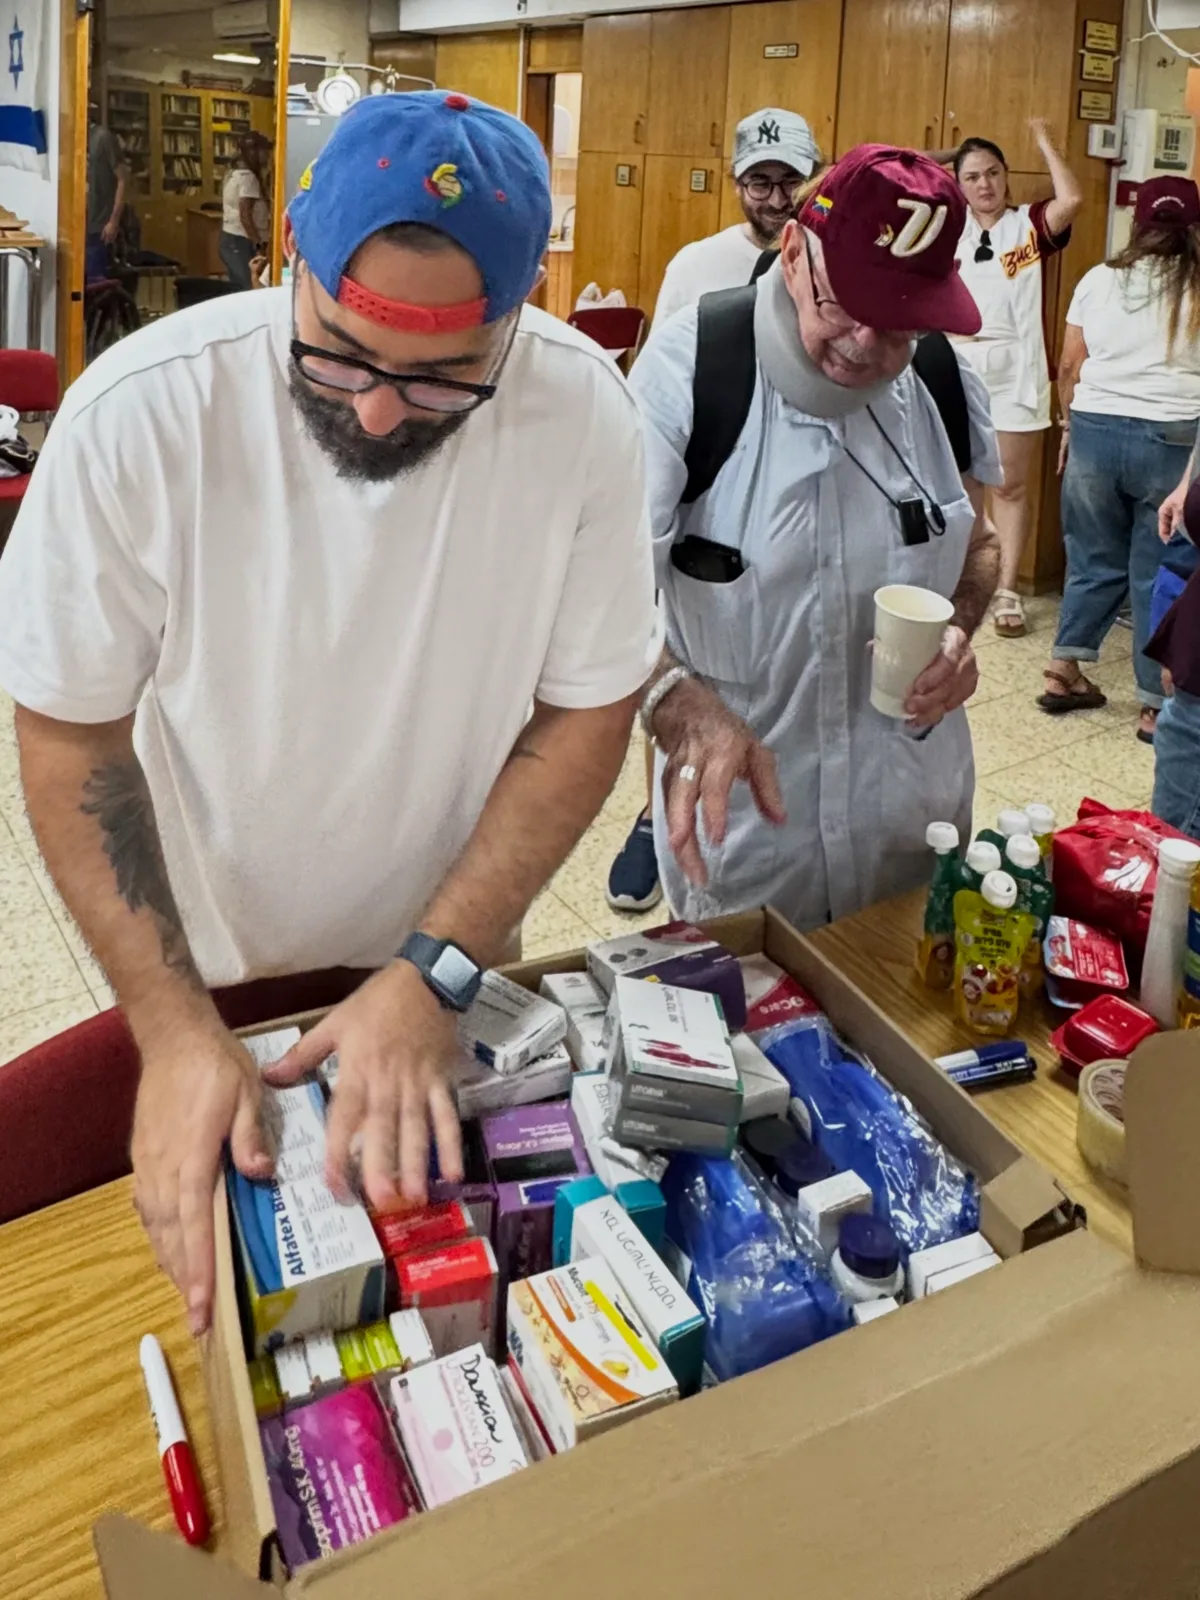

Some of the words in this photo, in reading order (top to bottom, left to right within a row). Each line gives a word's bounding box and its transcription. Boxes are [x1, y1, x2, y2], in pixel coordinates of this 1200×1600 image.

[758, 119, 780, 144] NY
[279, 1215, 305, 1276] Alfatex
[473, 1437, 496, 1468] 200
